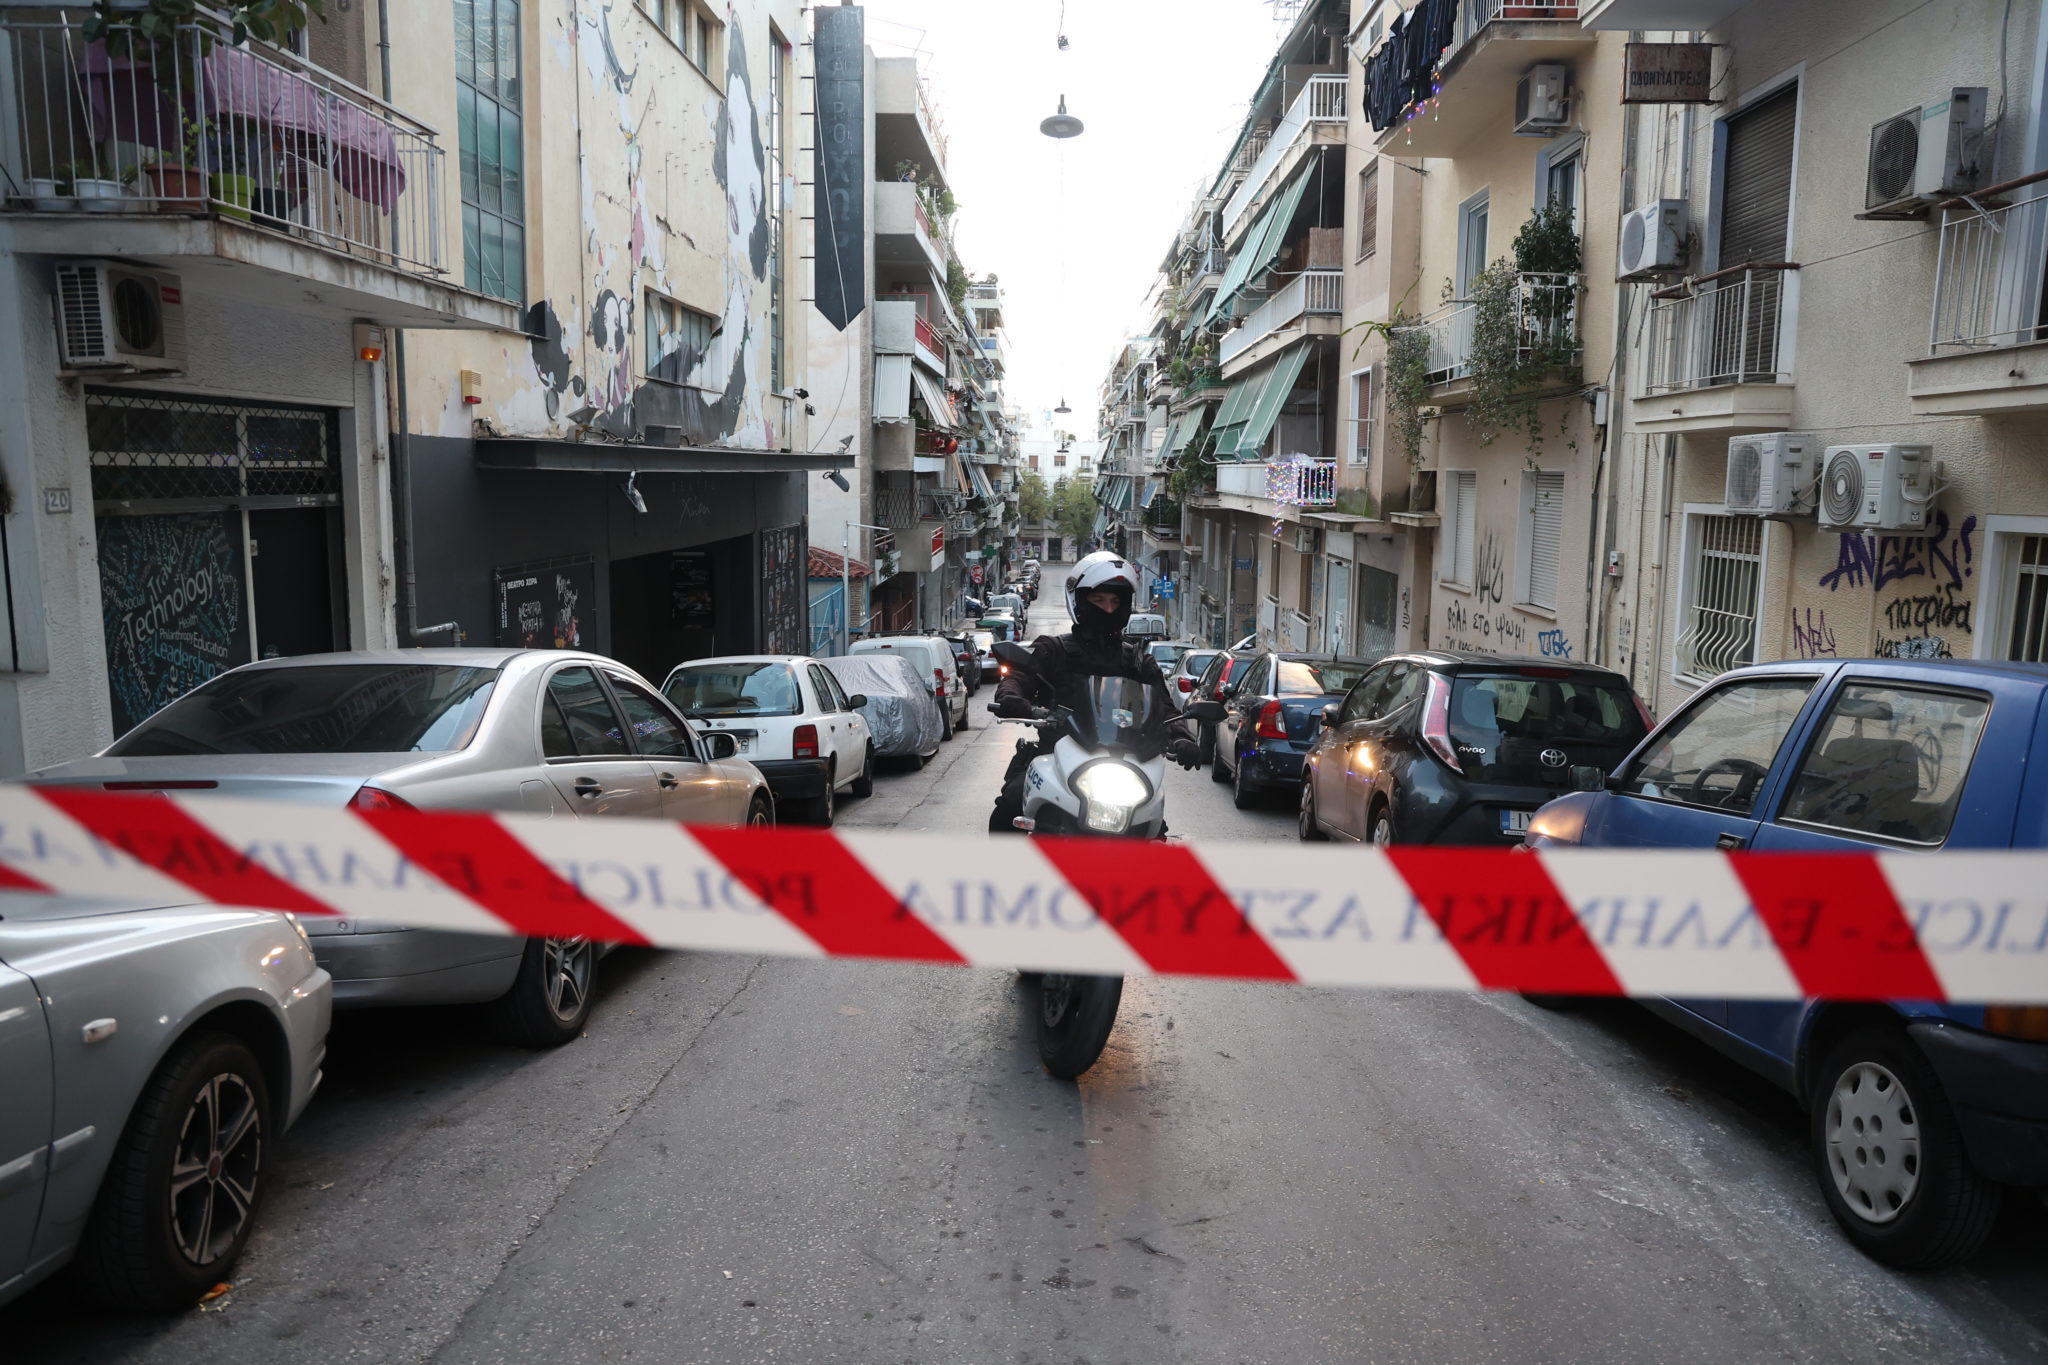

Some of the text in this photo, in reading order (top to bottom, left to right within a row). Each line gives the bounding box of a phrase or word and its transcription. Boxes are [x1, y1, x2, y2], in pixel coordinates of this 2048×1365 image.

[49, 493, 68, 509] 20
[147, 535, 181, 602] Travel
[1164, 581, 1172, 590] P
[122, 563, 213, 649] Technology
[124, 588, 146, 612] social
[178, 612, 199, 631] Health
[159, 628, 195, 645] Philanthropy
[193, 631, 229, 658] Education
[119, 624, 152, 702] Innovation
[153, 631, 217, 680] Leadership
[1458, 745, 1486, 754] AYGO
